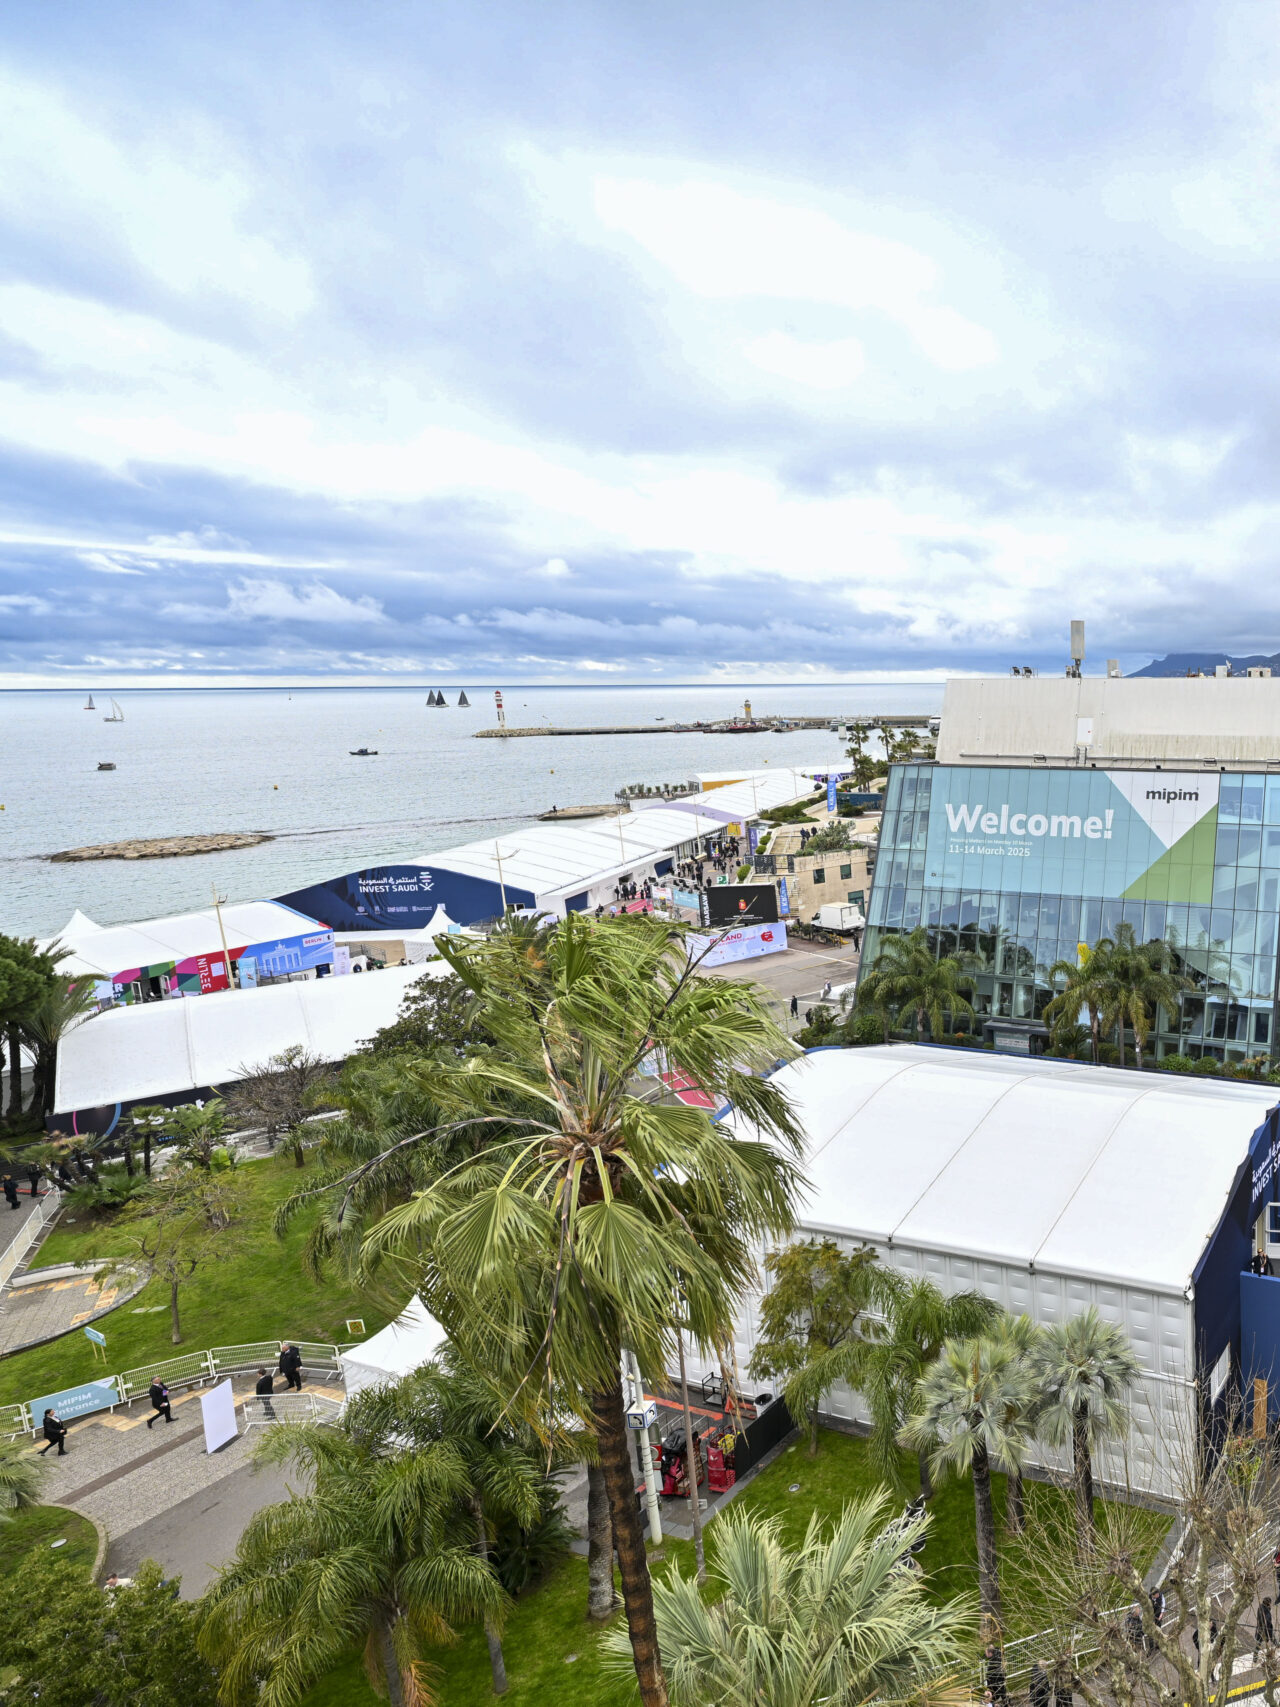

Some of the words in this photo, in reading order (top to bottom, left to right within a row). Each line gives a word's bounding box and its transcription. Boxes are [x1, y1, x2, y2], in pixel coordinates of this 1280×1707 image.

[1146, 788, 1199, 803] mipim
[945, 804, 1114, 839] Welcome!
[949, 845, 974, 854] 11-14
[977, 846, 1005, 855] March
[1008, 847, 1030, 857] 2025
[360, 885, 390, 893] INVEST
[392, 884, 418, 892] SAUDI
[702, 894, 711, 926] WARSAW
[710, 933, 742, 945] PLAND
[1252, 1164, 1273, 1203] INVEST
[58, 1392, 92, 1408] MIPIM
